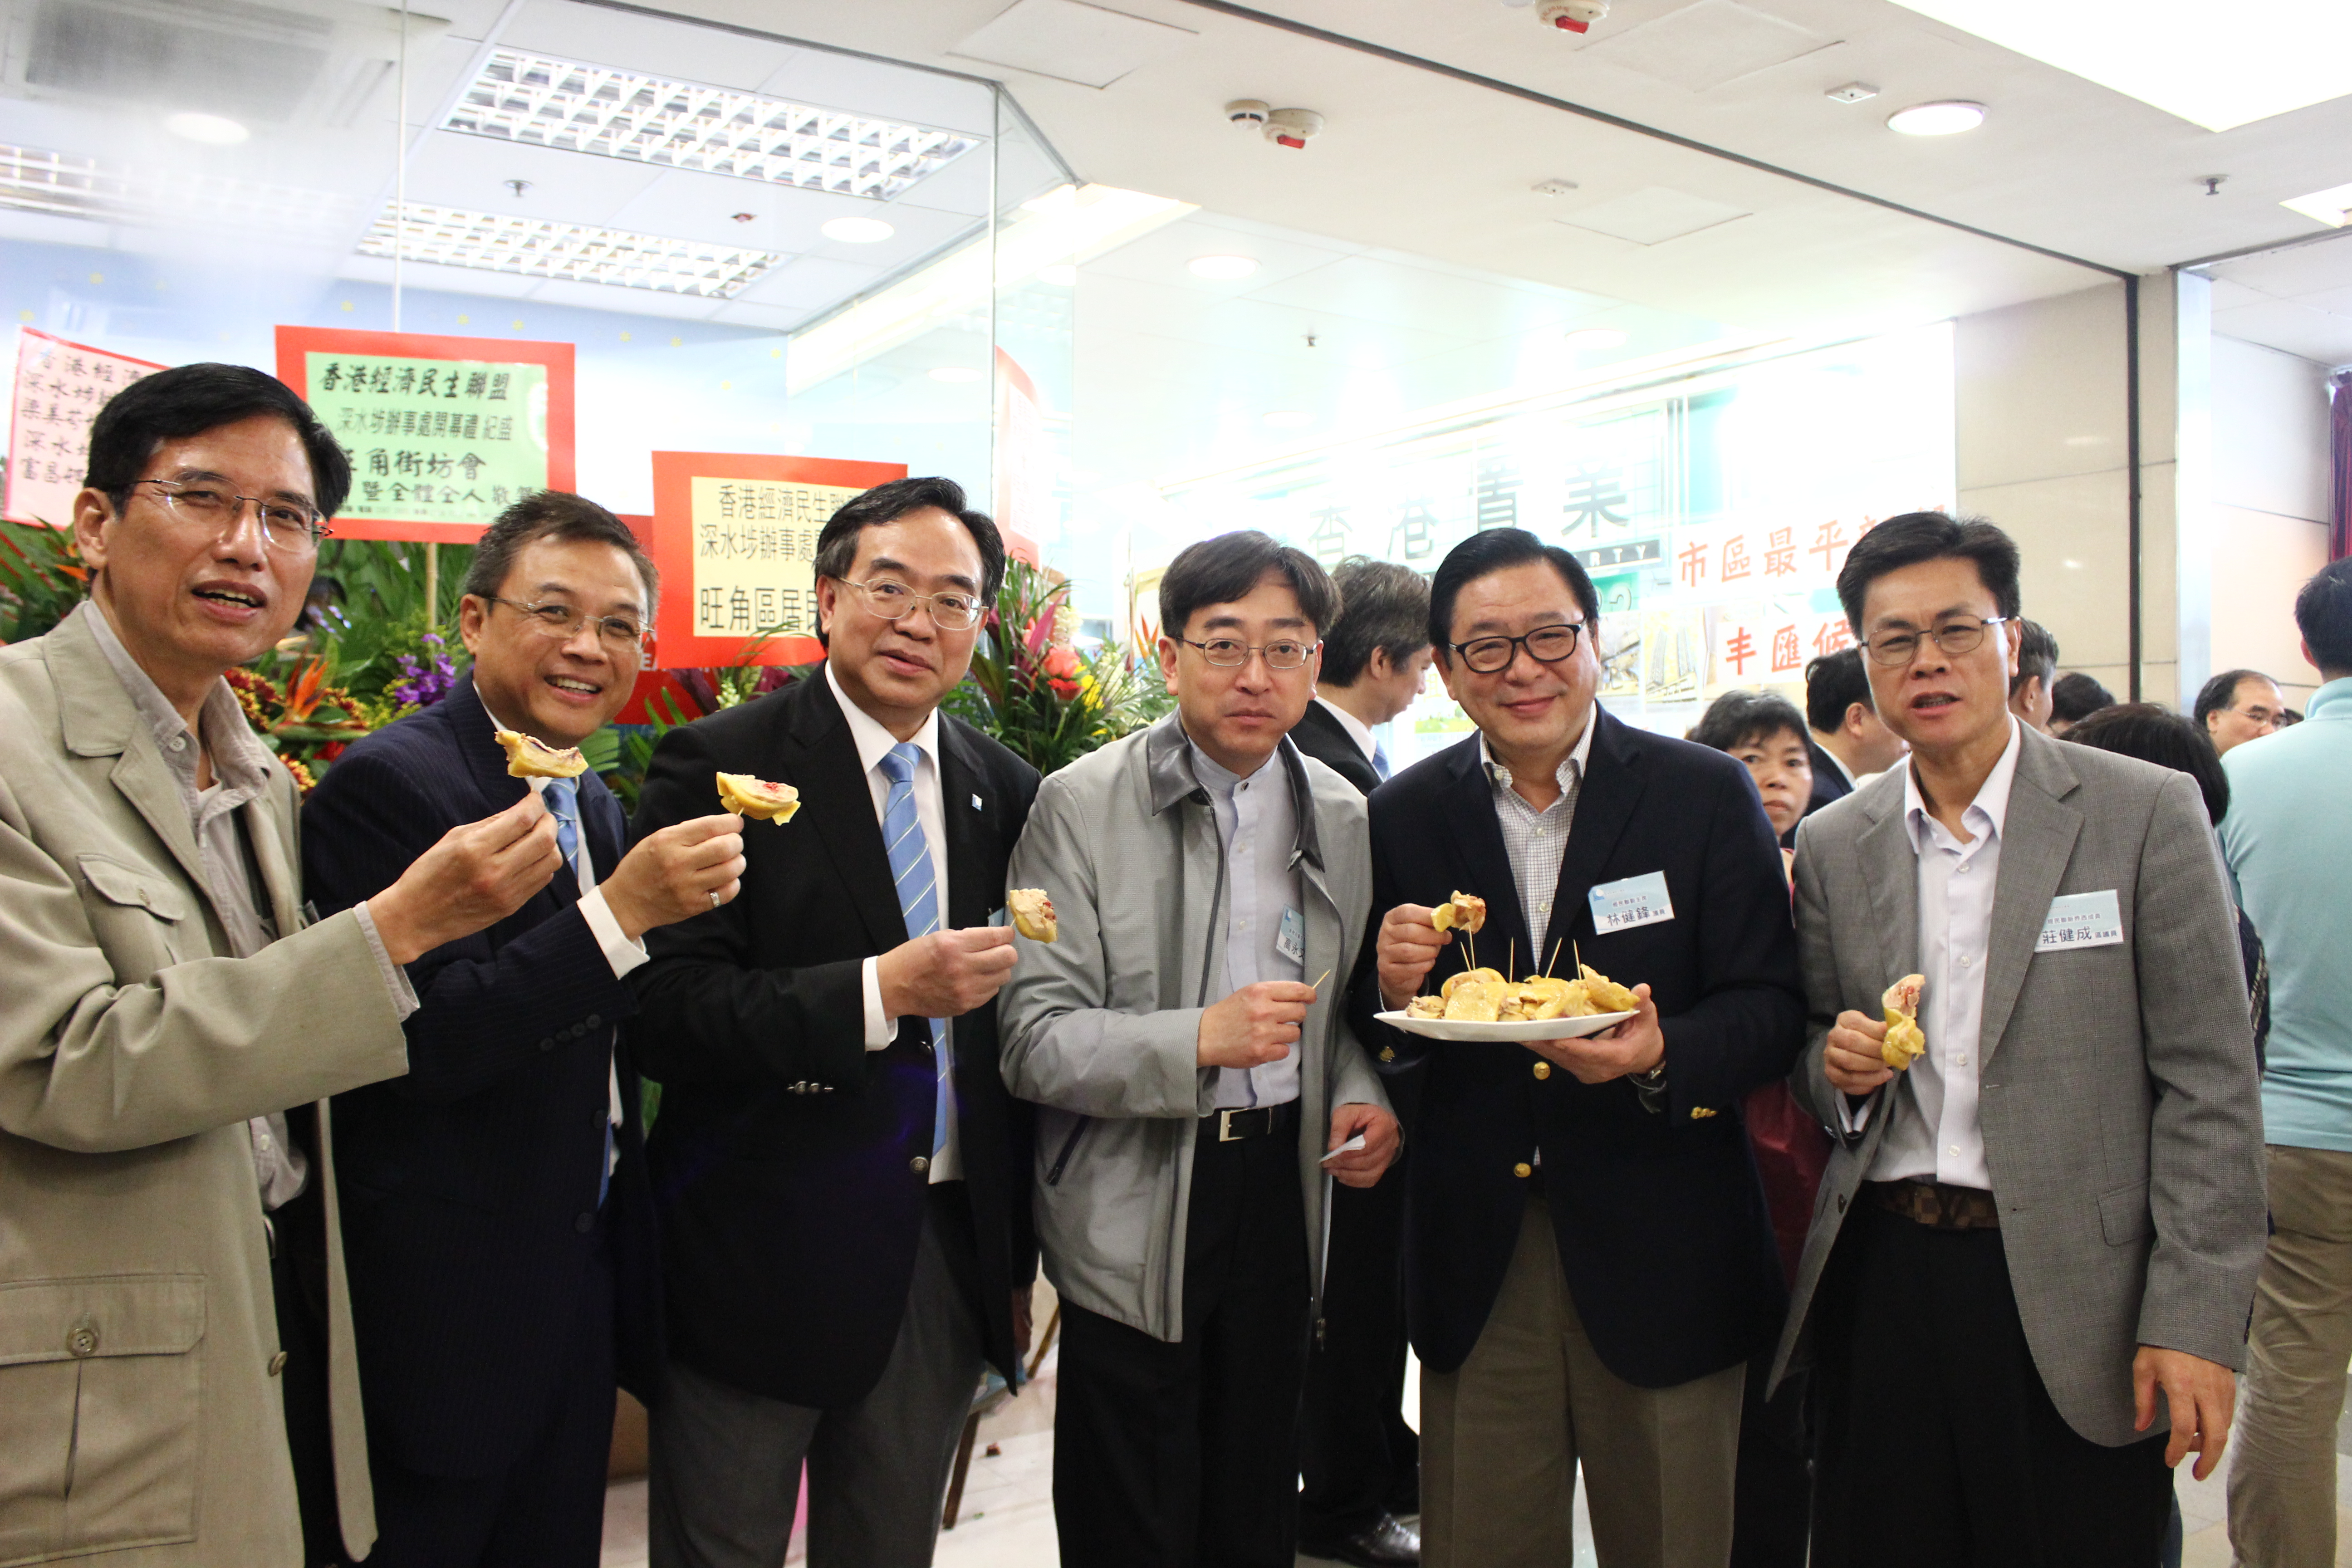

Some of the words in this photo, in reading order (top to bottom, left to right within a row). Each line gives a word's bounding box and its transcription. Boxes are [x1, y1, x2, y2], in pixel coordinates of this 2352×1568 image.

[319, 362, 510, 400] 香港經濟民生聯盟
[718, 484, 855, 524] 香港經濟民生
[1308, 458, 1630, 564] 香港置業
[700, 524, 822, 563] 深水埗辦事處
[1573, 544, 1646, 567] RTY
[1607, 906, 1650, 926] 林健鋒
[2042, 926, 2092, 944] 莊健成
